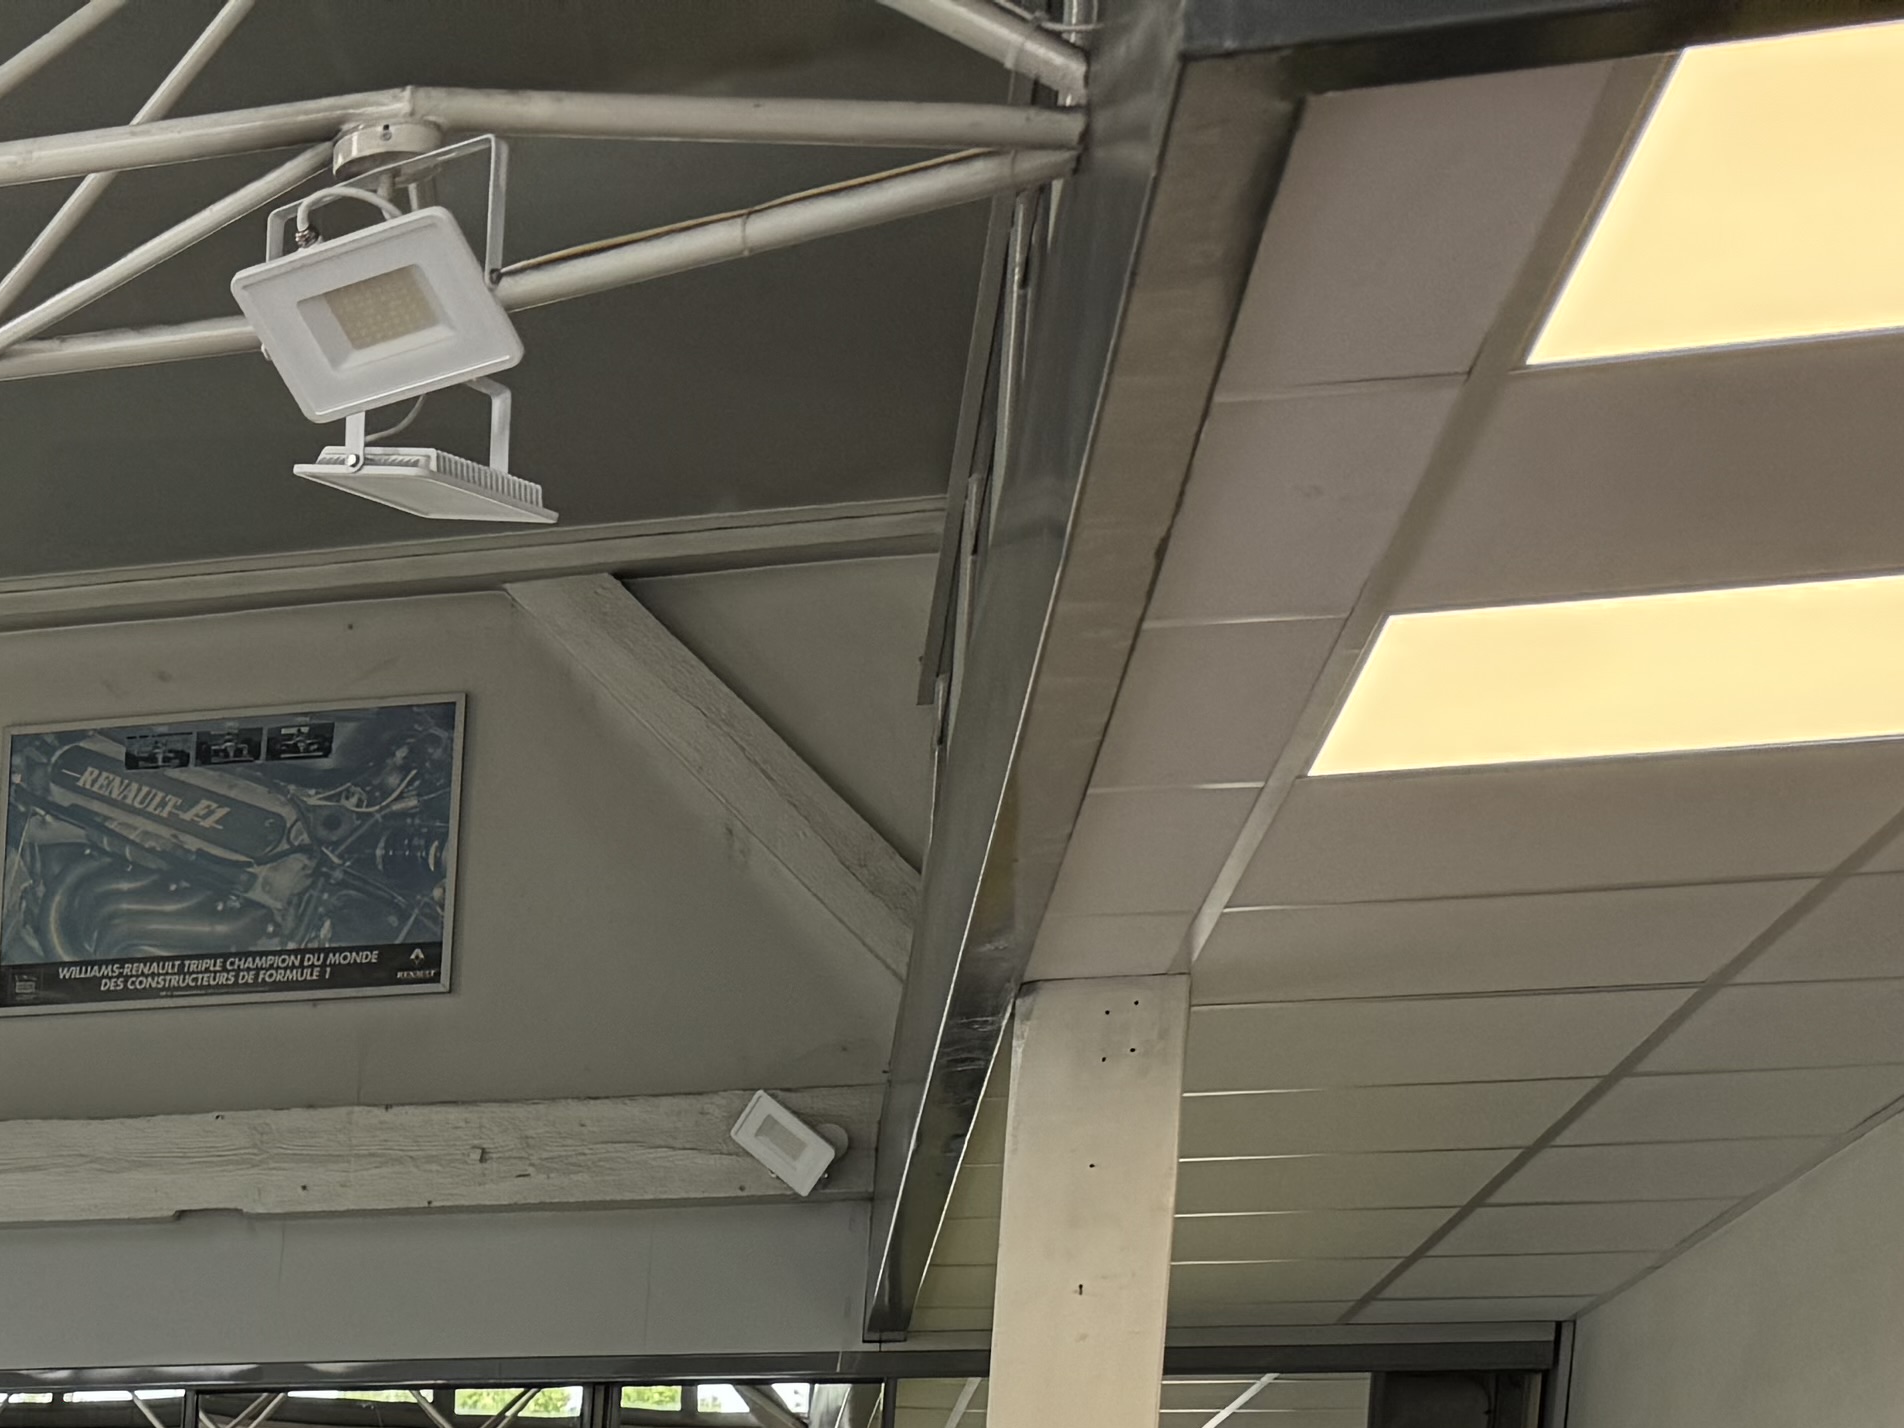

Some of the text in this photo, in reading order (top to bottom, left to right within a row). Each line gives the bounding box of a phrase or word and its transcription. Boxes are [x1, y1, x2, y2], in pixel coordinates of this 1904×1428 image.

[78, 766, 181, 818] RENAULT
[59, 949, 379, 980] WILLIAMS-RENAULT TRIPLE CHAMPION DU MONDE
[100, 966, 331, 992] DES CONSTRUCTEURS DE FORMULE 1
